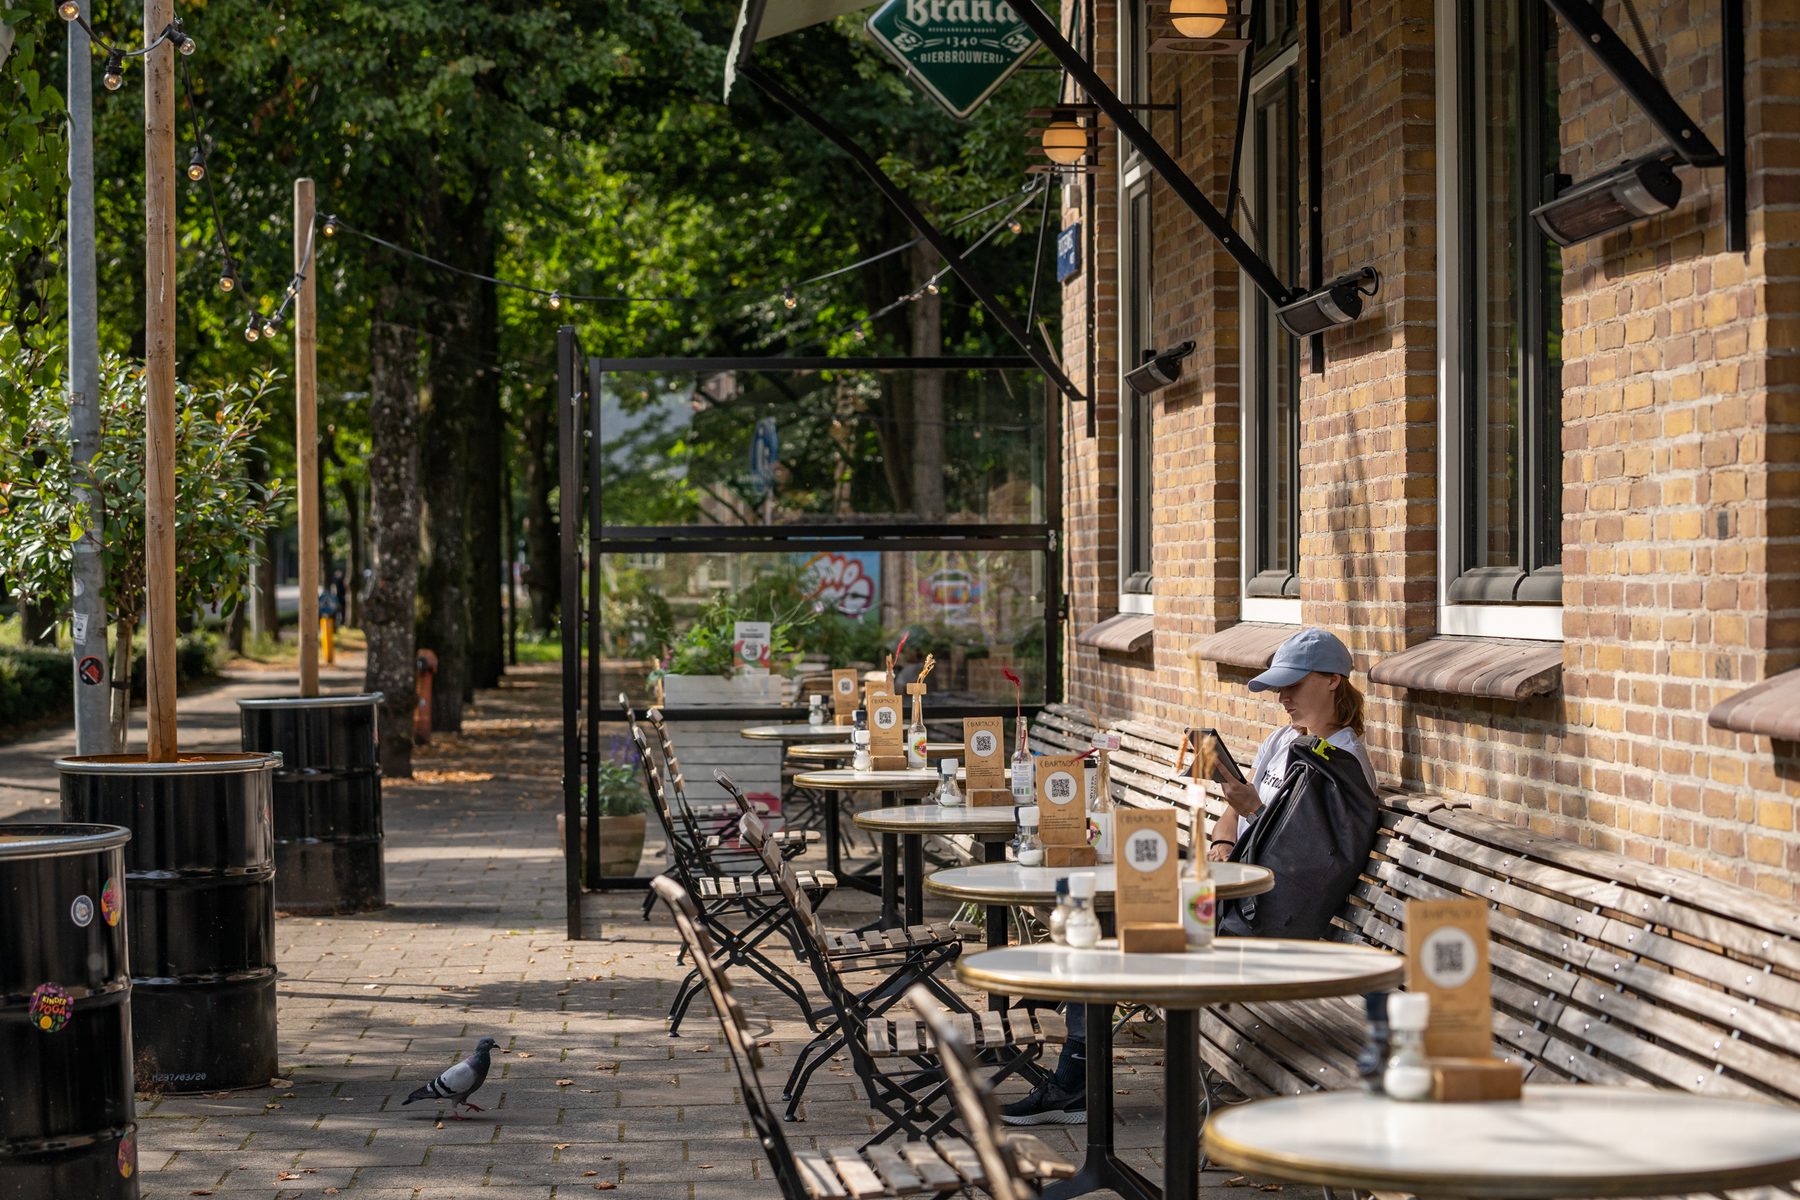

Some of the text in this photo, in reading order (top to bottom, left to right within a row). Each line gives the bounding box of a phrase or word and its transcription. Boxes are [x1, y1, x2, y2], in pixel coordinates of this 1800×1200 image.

[946, 36, 978, 48] 1340
[920, 50, 1004, 64] BIERBROUWERIJ
[42, 995, 67, 1006] KINDER
[40, 1002, 66, 1016] YOGA
